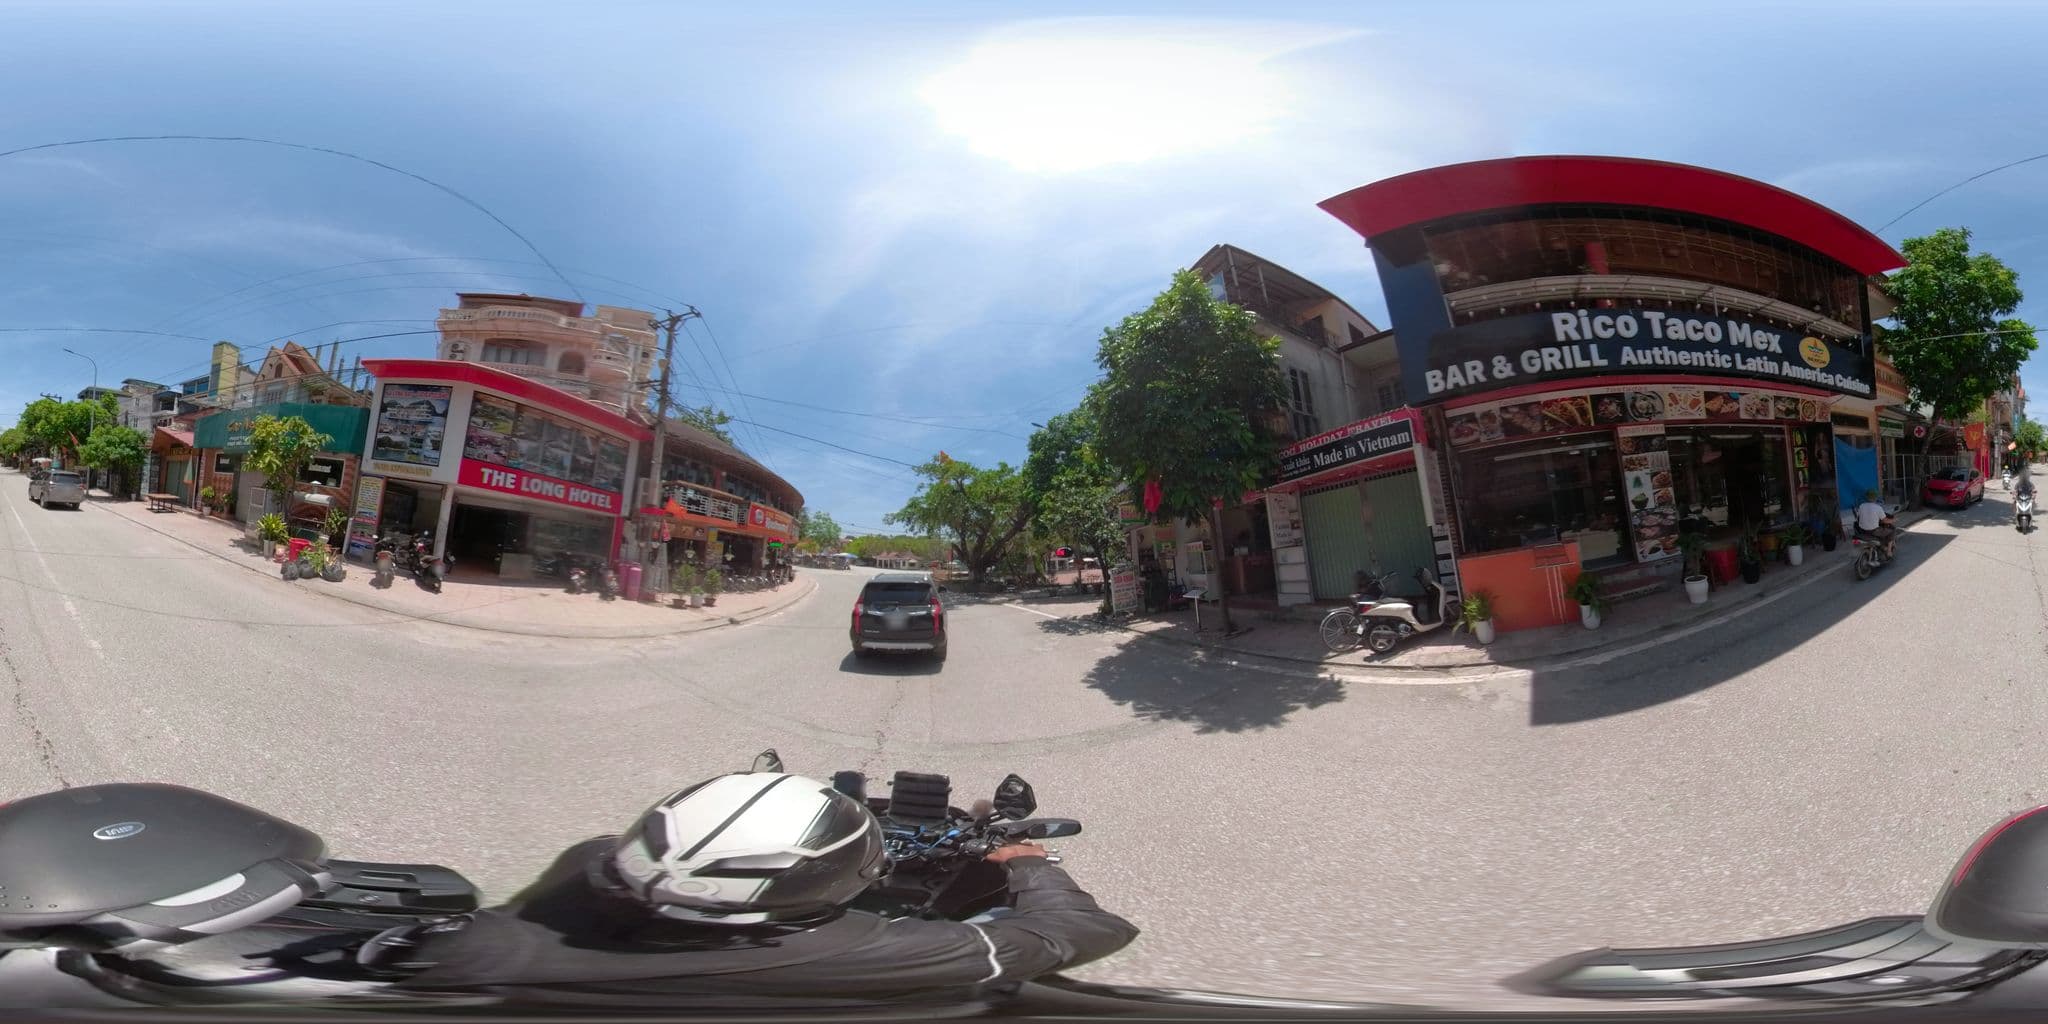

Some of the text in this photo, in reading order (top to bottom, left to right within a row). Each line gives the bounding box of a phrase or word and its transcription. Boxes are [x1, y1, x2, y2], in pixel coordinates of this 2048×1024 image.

[1551, 309, 1783, 353] Rico Taco Mex
[1424, 344, 1870, 395] BAR & GRILL Authentic Latin America Cuisine
[1299, 431, 1344, 452] HOLIDAY
[1347, 415, 1396, 435] TRAVEL
[1313, 431, 1410, 468] Made in Vietnam
[480, 467, 612, 509] THE LONG HOTEL
